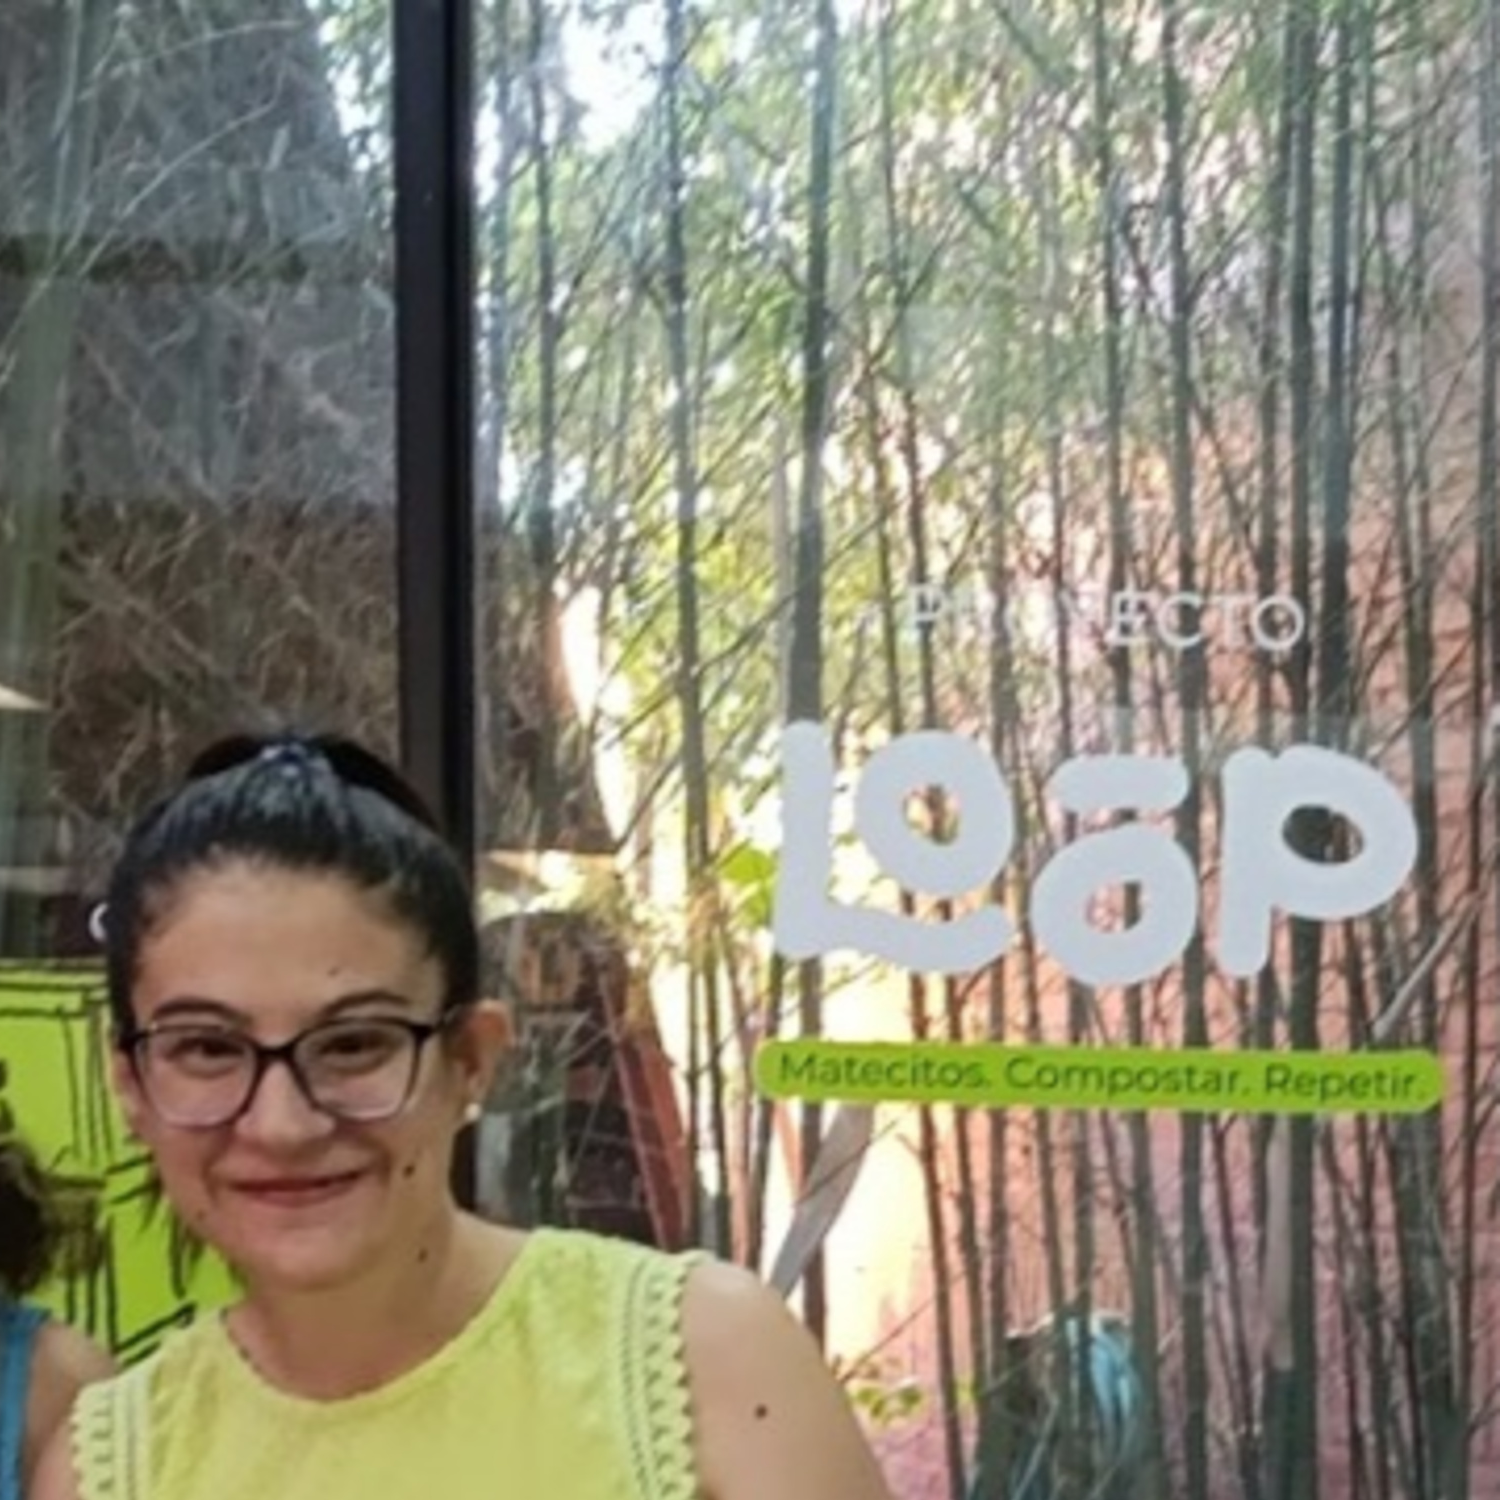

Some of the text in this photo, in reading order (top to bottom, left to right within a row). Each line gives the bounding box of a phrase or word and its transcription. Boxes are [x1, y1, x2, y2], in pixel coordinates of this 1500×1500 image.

[908, 583, 1304, 652] PECTO
[779, 1053, 992, 1090] Matecitos.
[1005, 1056, 1250, 1096] Compostar.
